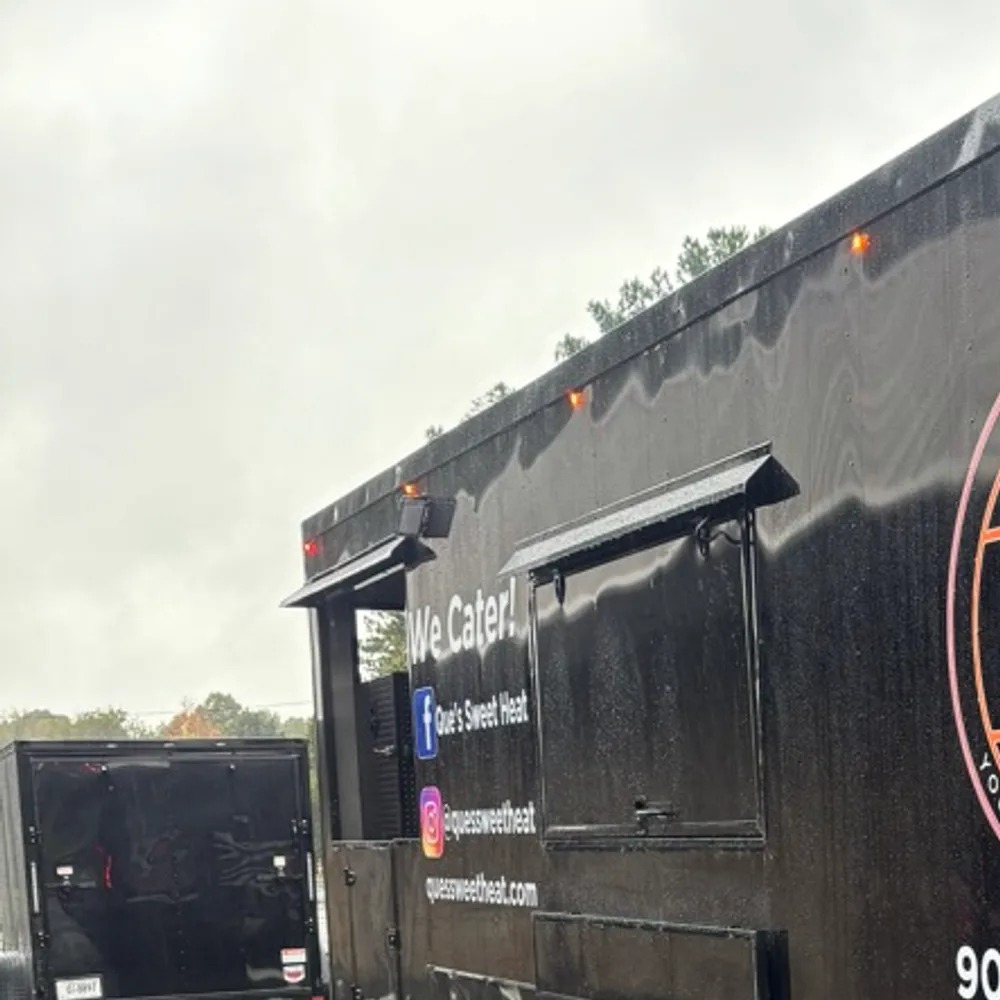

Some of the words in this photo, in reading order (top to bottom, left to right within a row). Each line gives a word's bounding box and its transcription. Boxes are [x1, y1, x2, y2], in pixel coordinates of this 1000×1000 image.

[408, 605, 441, 665] We
[448, 576, 516, 653] Cater!
[436, 702, 463, 736] Que's
[465, 695, 498, 731] Sweet
[499, 690, 529, 725] Heat
